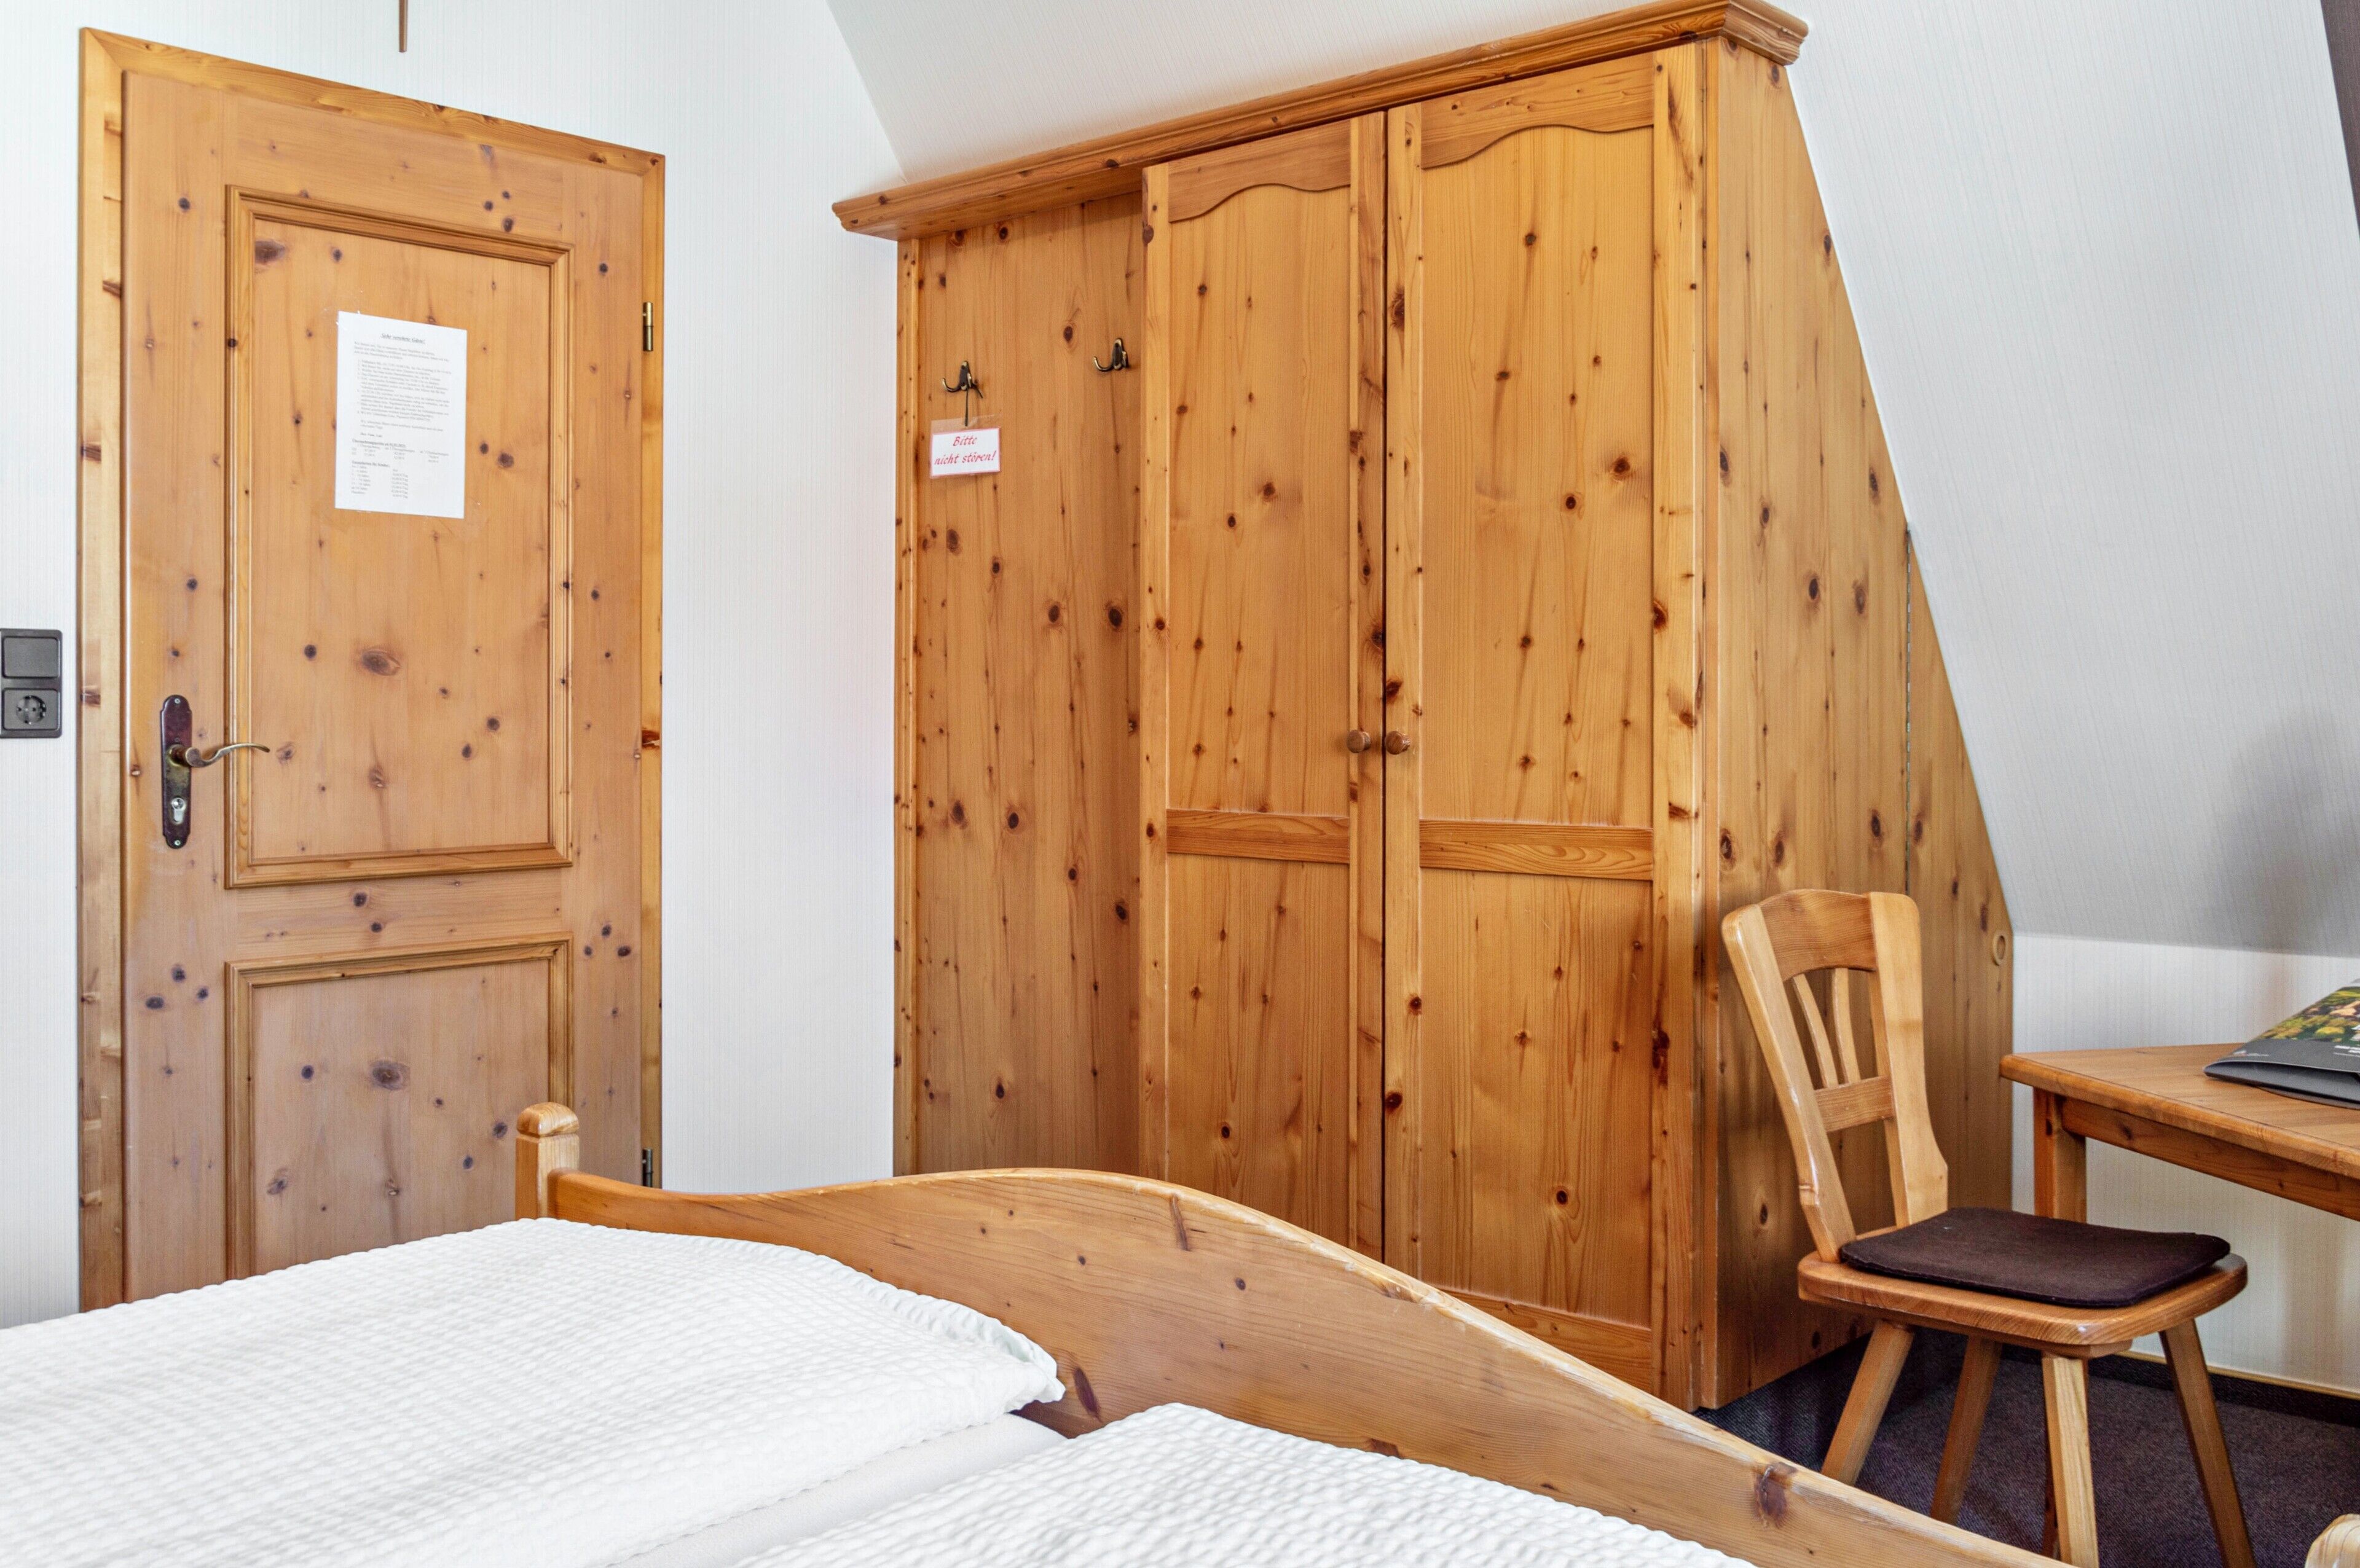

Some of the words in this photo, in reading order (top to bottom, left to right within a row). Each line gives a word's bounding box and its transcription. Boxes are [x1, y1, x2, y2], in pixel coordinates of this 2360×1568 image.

[953, 436, 978, 447] Bitte
[934, 453, 959, 465] nicht
[962, 450, 996, 463] stören!
